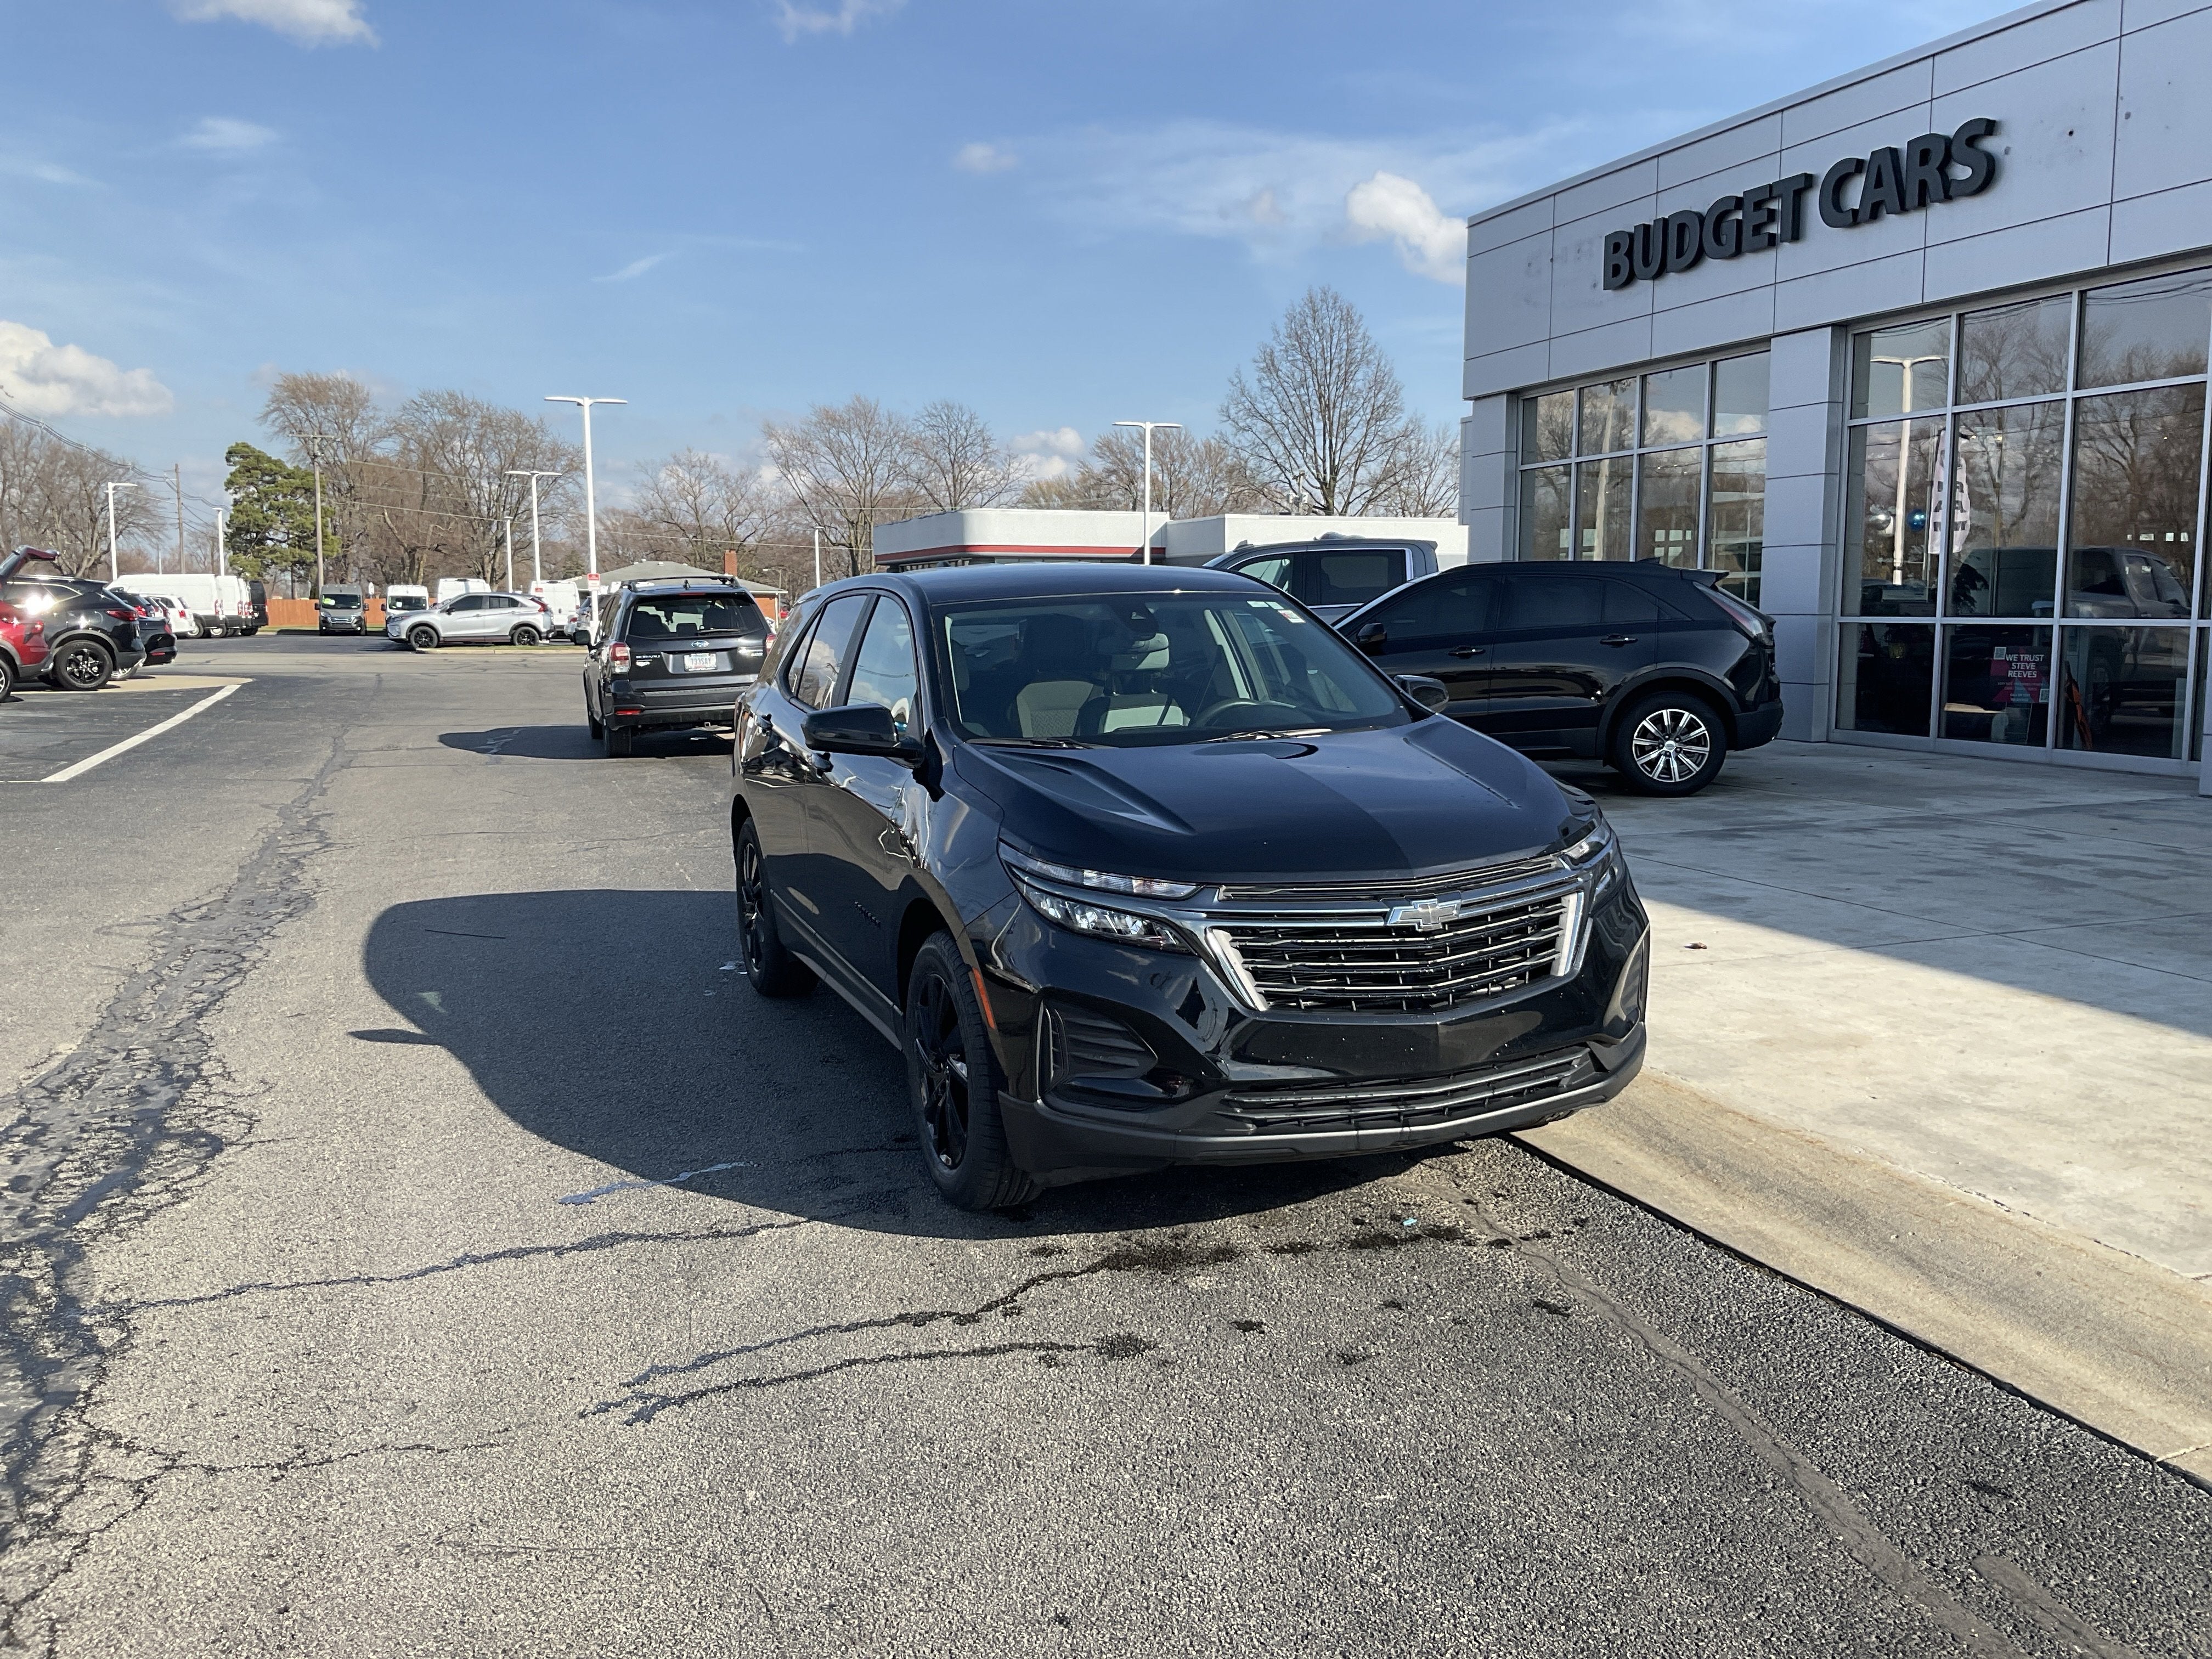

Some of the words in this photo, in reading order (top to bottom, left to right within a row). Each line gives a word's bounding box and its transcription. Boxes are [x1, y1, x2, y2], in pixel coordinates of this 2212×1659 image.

[1603, 172, 1813, 290] BUDGET
[1819, 117, 1996, 228] CARS
[2008, 670, 2037, 678] REEVES
